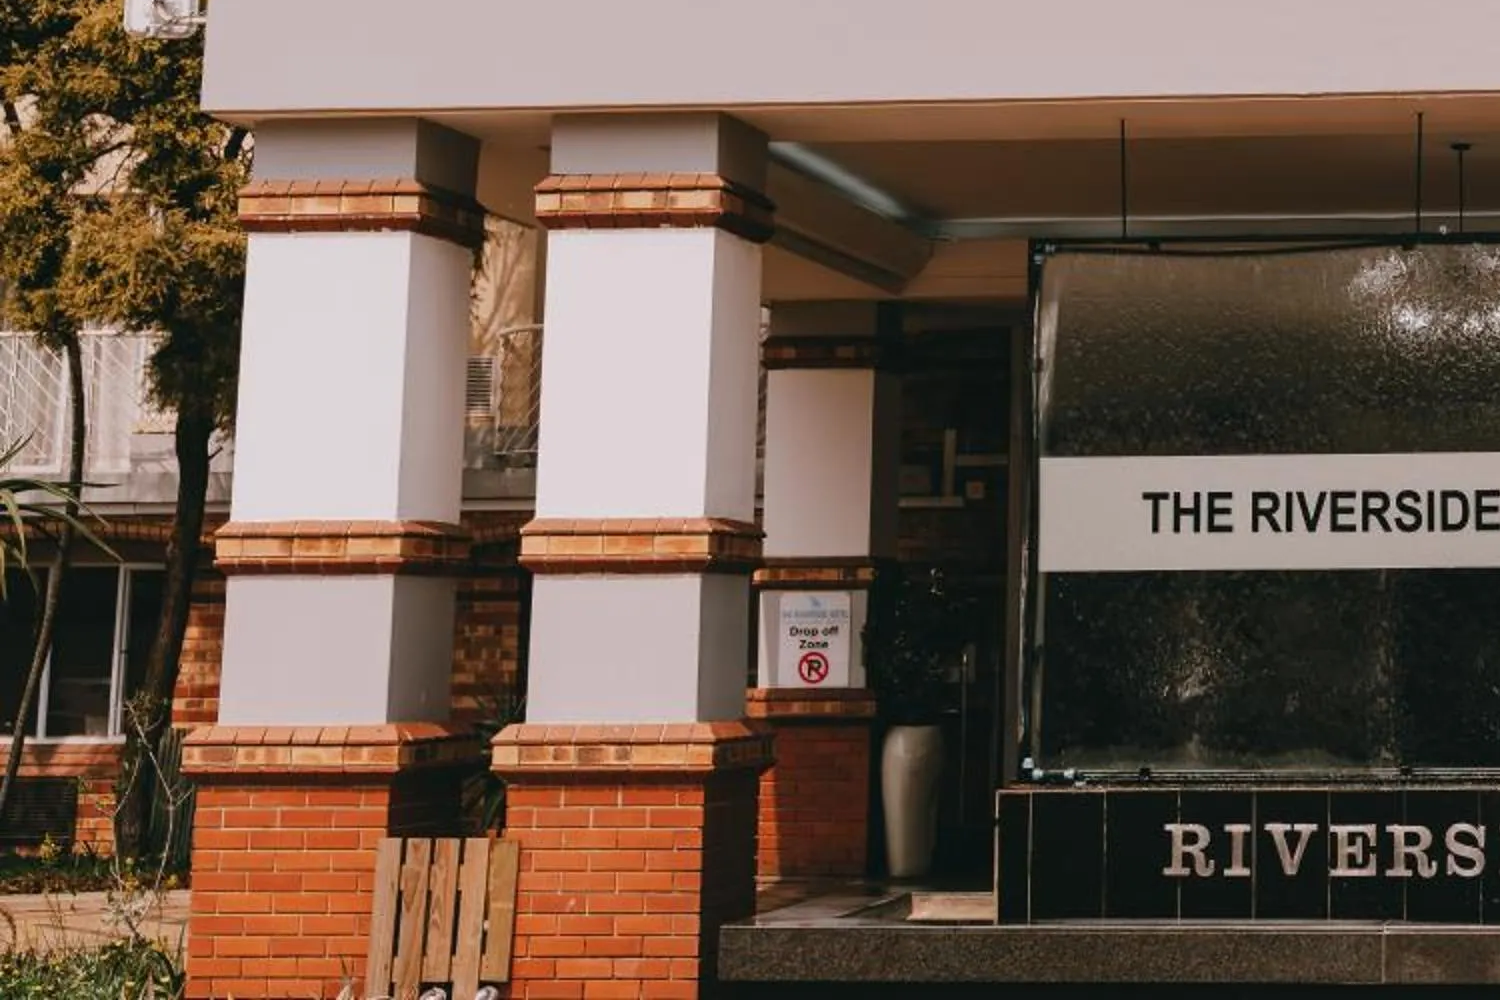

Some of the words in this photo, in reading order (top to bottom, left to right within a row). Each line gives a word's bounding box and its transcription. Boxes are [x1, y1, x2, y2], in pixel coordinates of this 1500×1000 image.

[1142, 491, 1234, 534] THE
[789, 626, 818, 638] Drop
[821, 625, 838, 636] off
[799, 640, 829, 649] Zone
